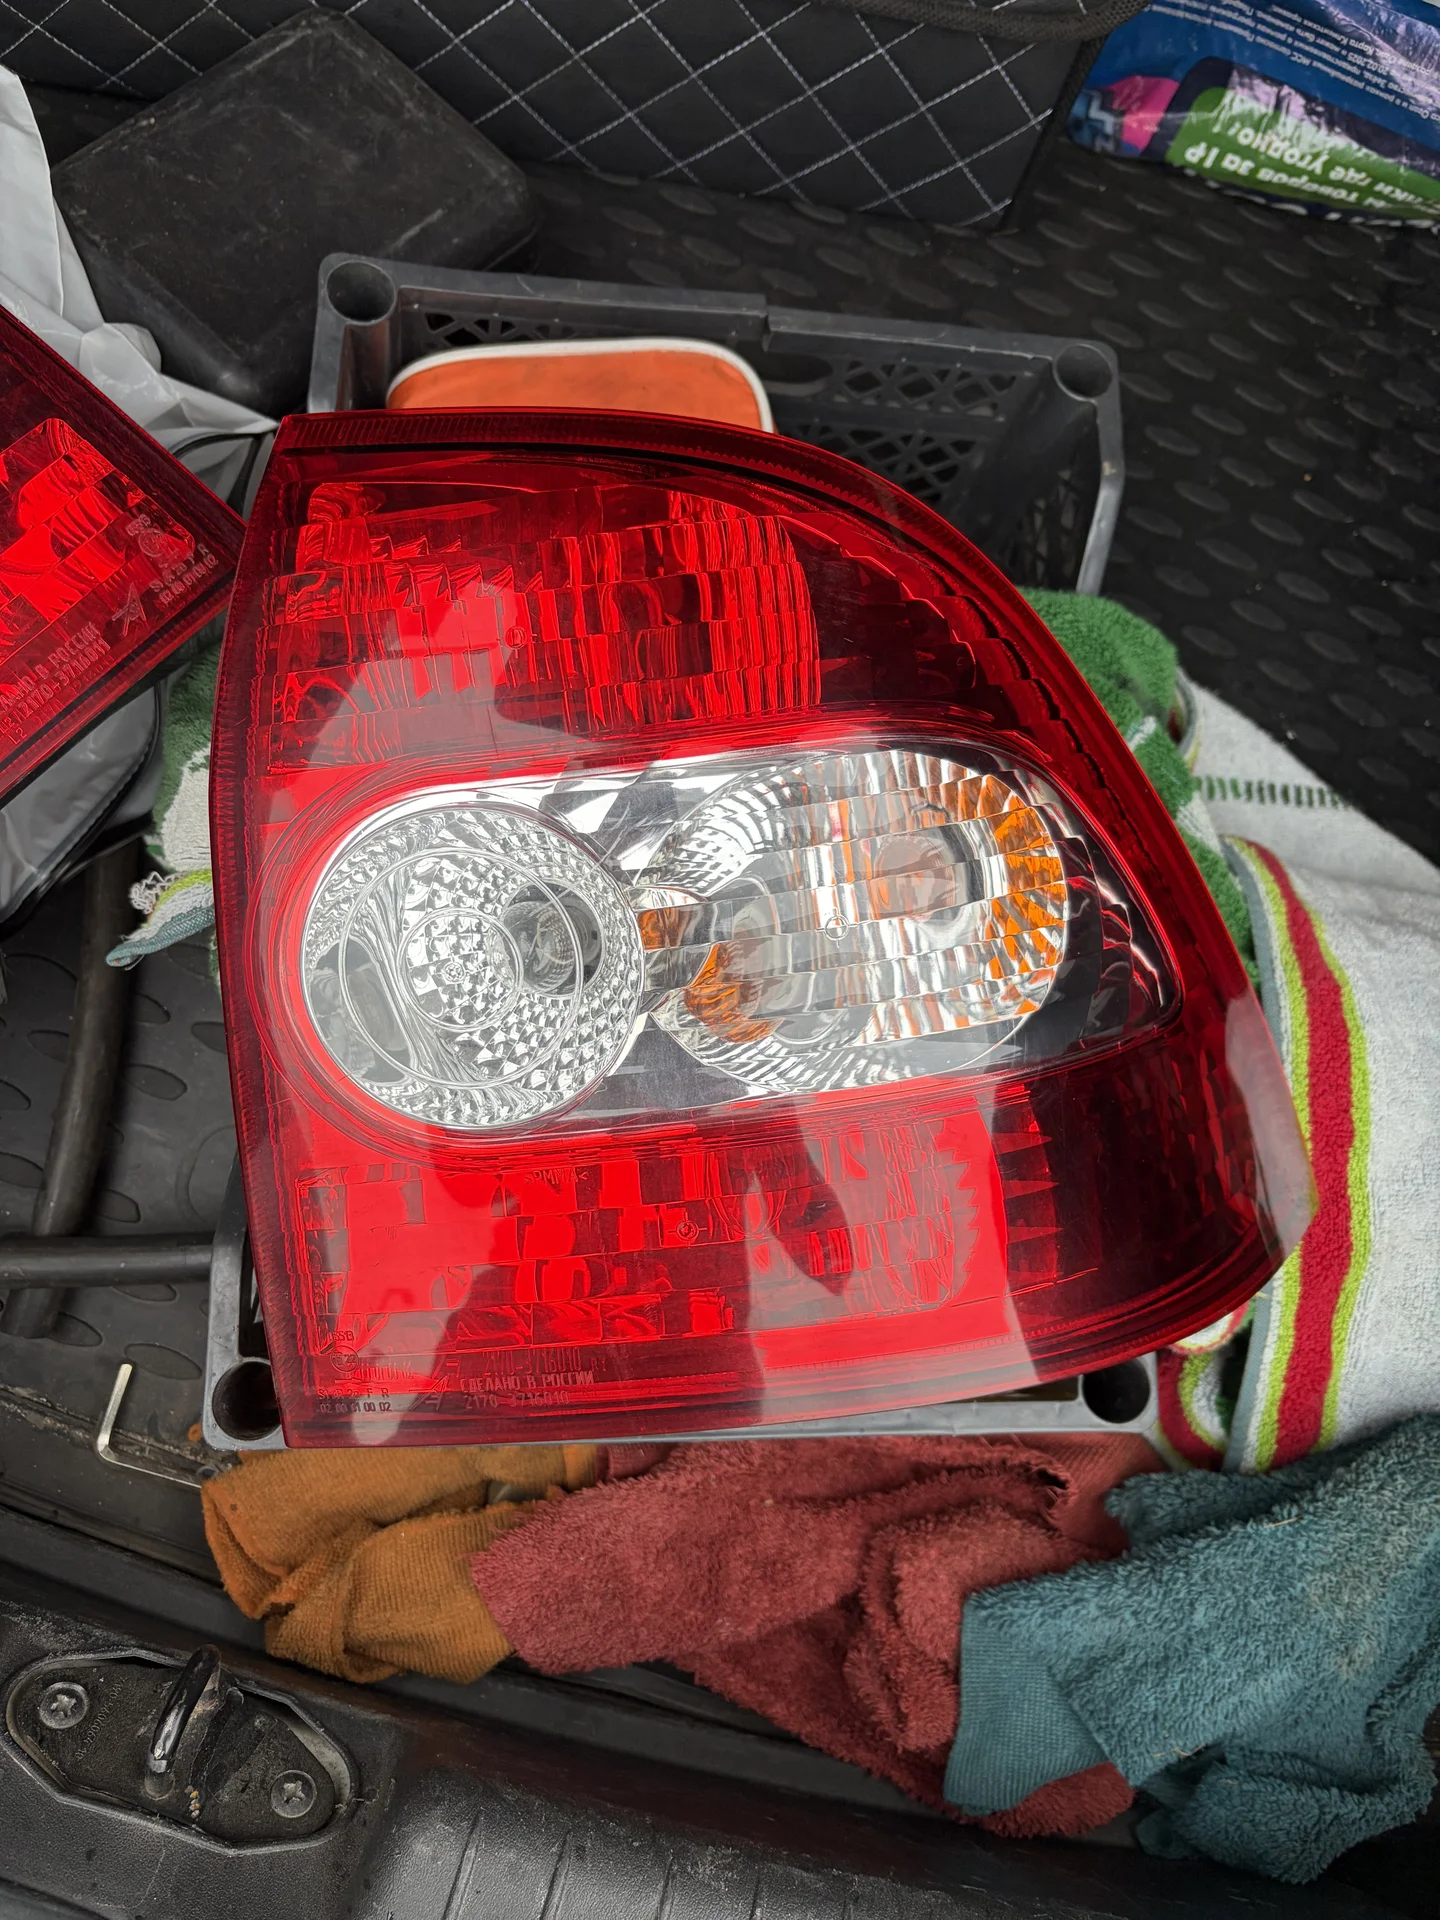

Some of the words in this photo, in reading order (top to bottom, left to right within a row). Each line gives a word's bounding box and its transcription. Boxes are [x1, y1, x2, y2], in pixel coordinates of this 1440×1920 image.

[1347, 36, 1375, 55] Карта
[1221, 152, 1255, 176] за
[1256, 167, 1359, 203] товаров
[1328, 165, 1372, 187] где
[380, 1387, 389, 1397] R
[459, 1374, 520, 1393] СДЕЛАНО
[526, 1374, 536, 1388] В
[541, 1370, 594, 1388] РОССИИ
[363, 1401, 375, 1411] 00
[378, 1401, 391, 1411] 02
